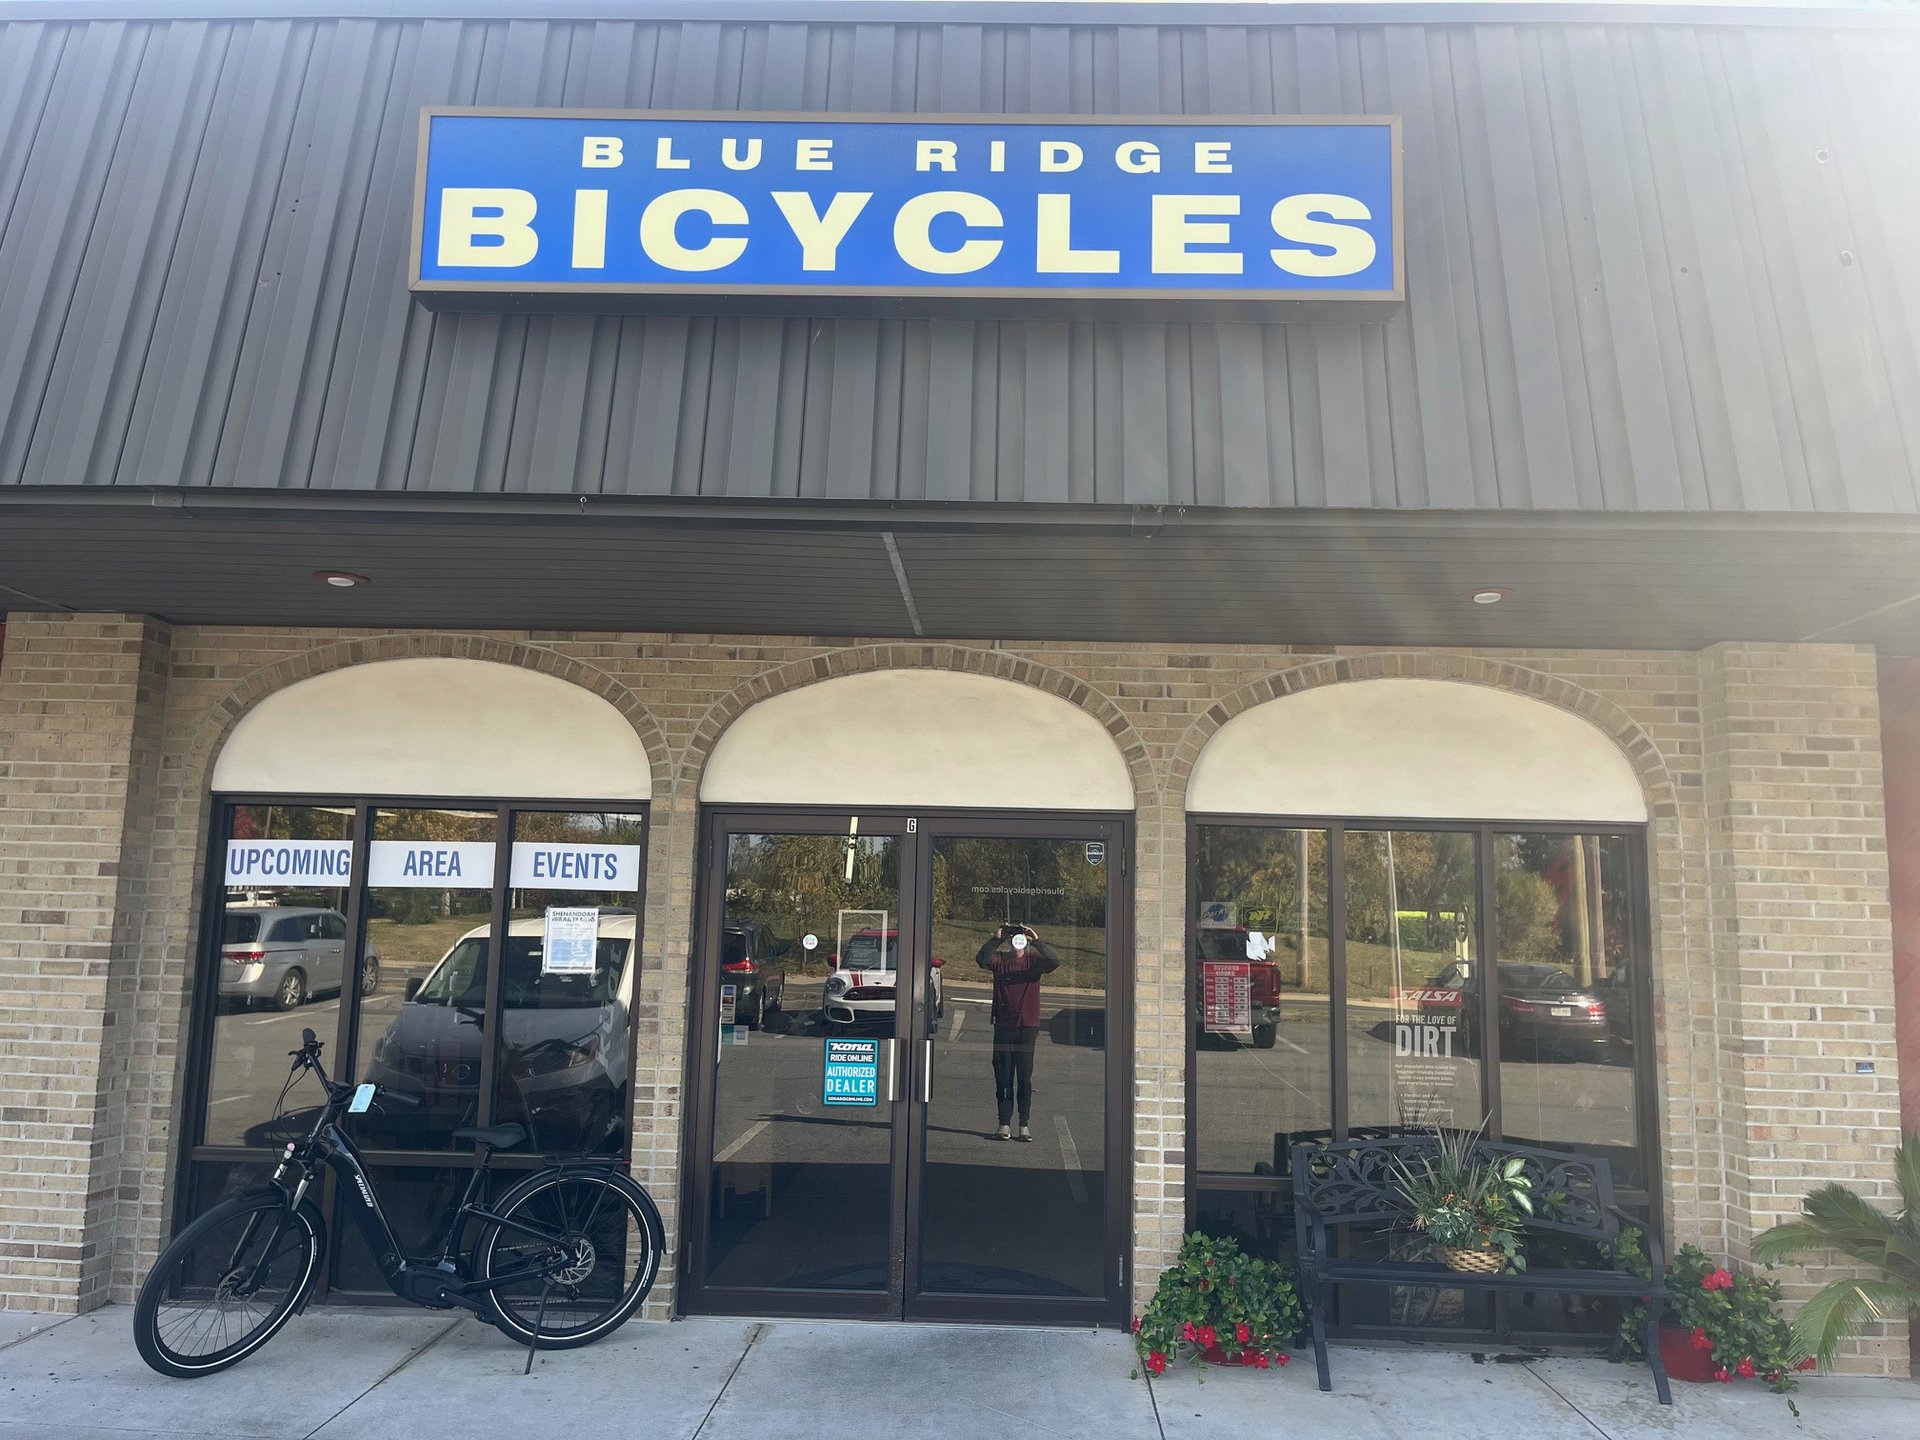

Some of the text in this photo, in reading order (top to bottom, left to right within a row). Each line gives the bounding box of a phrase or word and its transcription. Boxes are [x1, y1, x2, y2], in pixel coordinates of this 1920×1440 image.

[581, 135, 1233, 174] BLUE RIDGE
[437, 187, 1377, 277] BICYCLES
[909, 819, 915, 831] G
[230, 848, 350, 876] UPCOMING
[403, 850, 462, 877] AREA
[533, 851, 618, 880] EVENTS
[1396, 990, 1459, 1002] SALSA
[1395, 1014, 1457, 1025] FOR THE LOVE OF
[1395, 1025, 1457, 1058] DIRT
[830, 1054, 874, 1062] RIDE ONLINE
[827, 1066, 876, 1078] AUTHORIZED
[827, 1078, 875, 1093] DEALER
